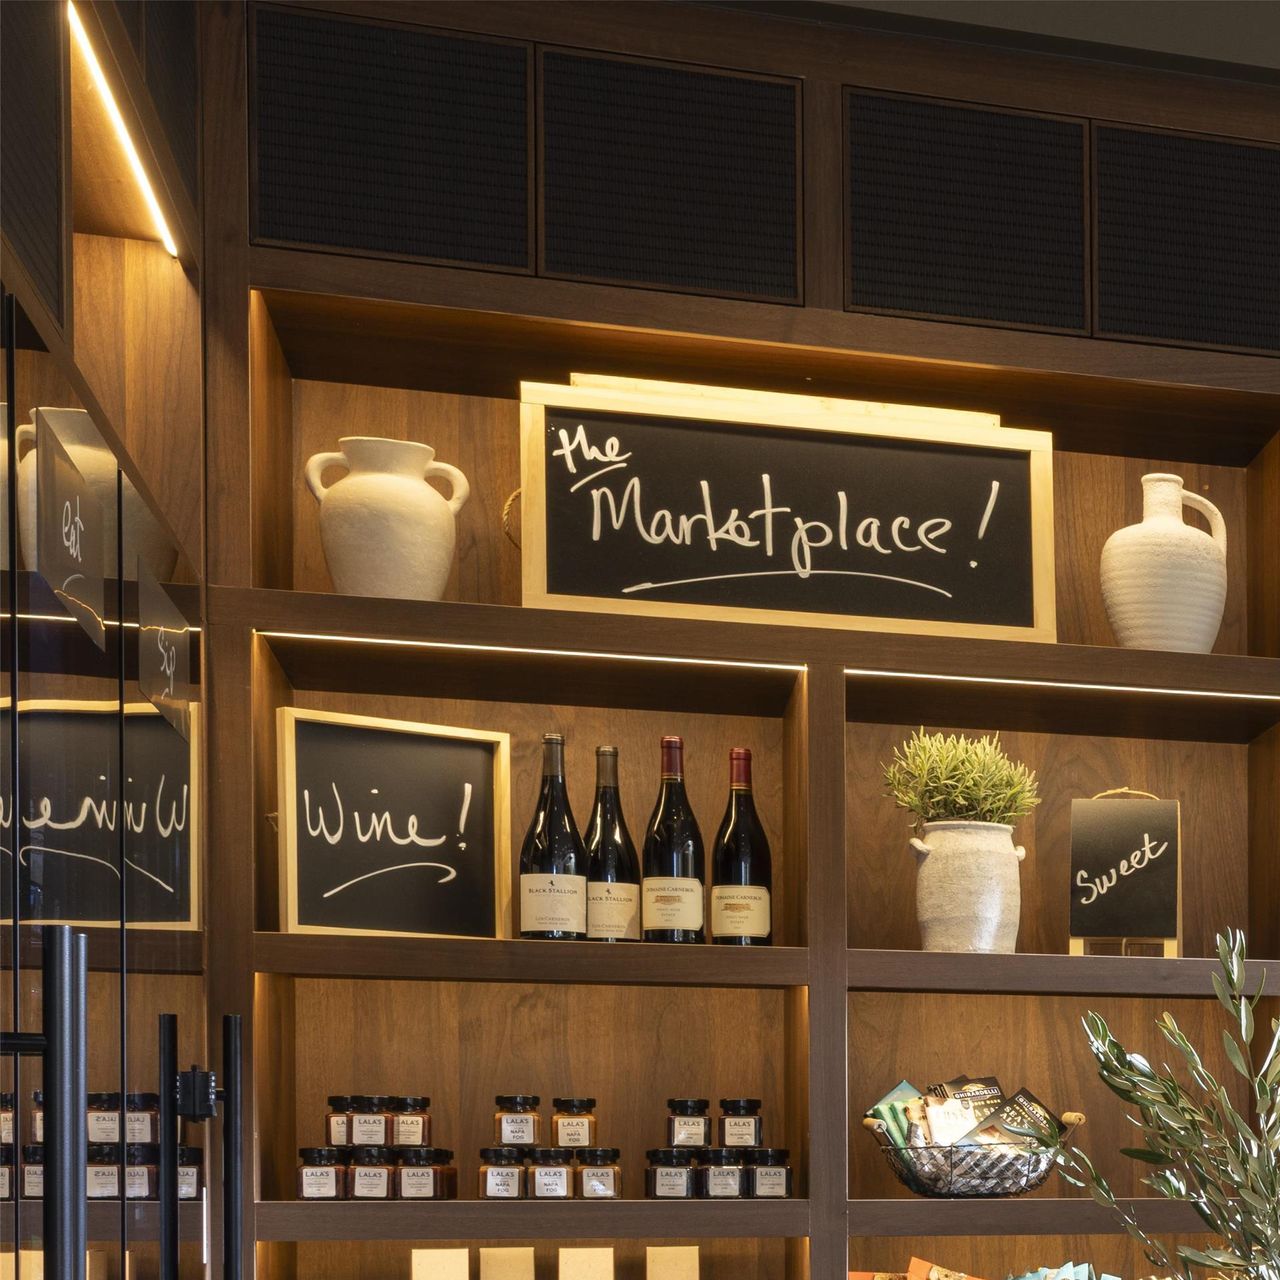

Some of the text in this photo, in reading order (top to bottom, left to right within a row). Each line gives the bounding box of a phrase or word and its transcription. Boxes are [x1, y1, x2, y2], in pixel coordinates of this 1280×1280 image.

[553, 424, 632, 473] the
[1077, 832, 1169, 904] Sweet
[953, 1087, 999, 1099] GHIRARDELLI
